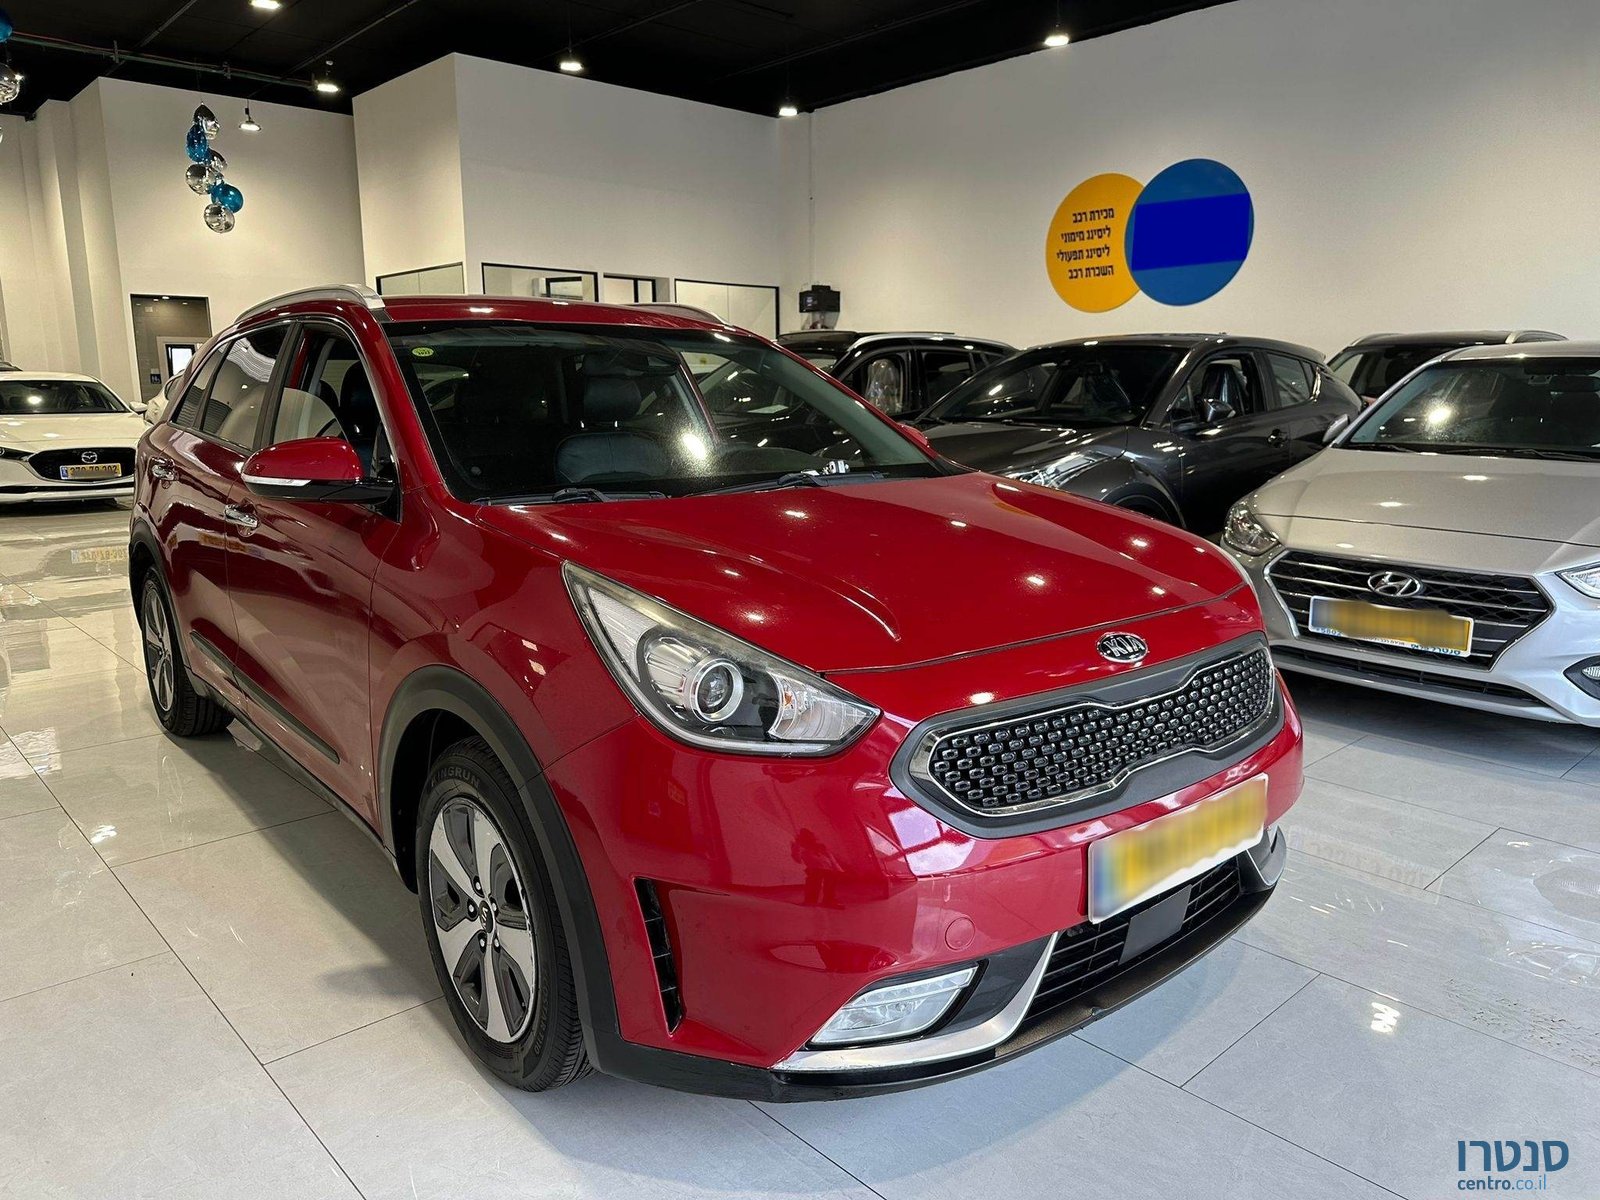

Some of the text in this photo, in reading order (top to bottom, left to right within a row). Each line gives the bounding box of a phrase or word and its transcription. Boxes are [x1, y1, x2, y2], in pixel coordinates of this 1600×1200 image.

[1072, 208, 1114, 223] מכירת רכב
[1061, 225, 1111, 243] ליסינג מימוני
[1056, 244, 1110, 262] ליסינג תפעולי
[1068, 265, 1114, 279] השכרת רכב
[1103, 635, 1146, 657] KIA
[431, 766, 481, 789] KINGRUN
